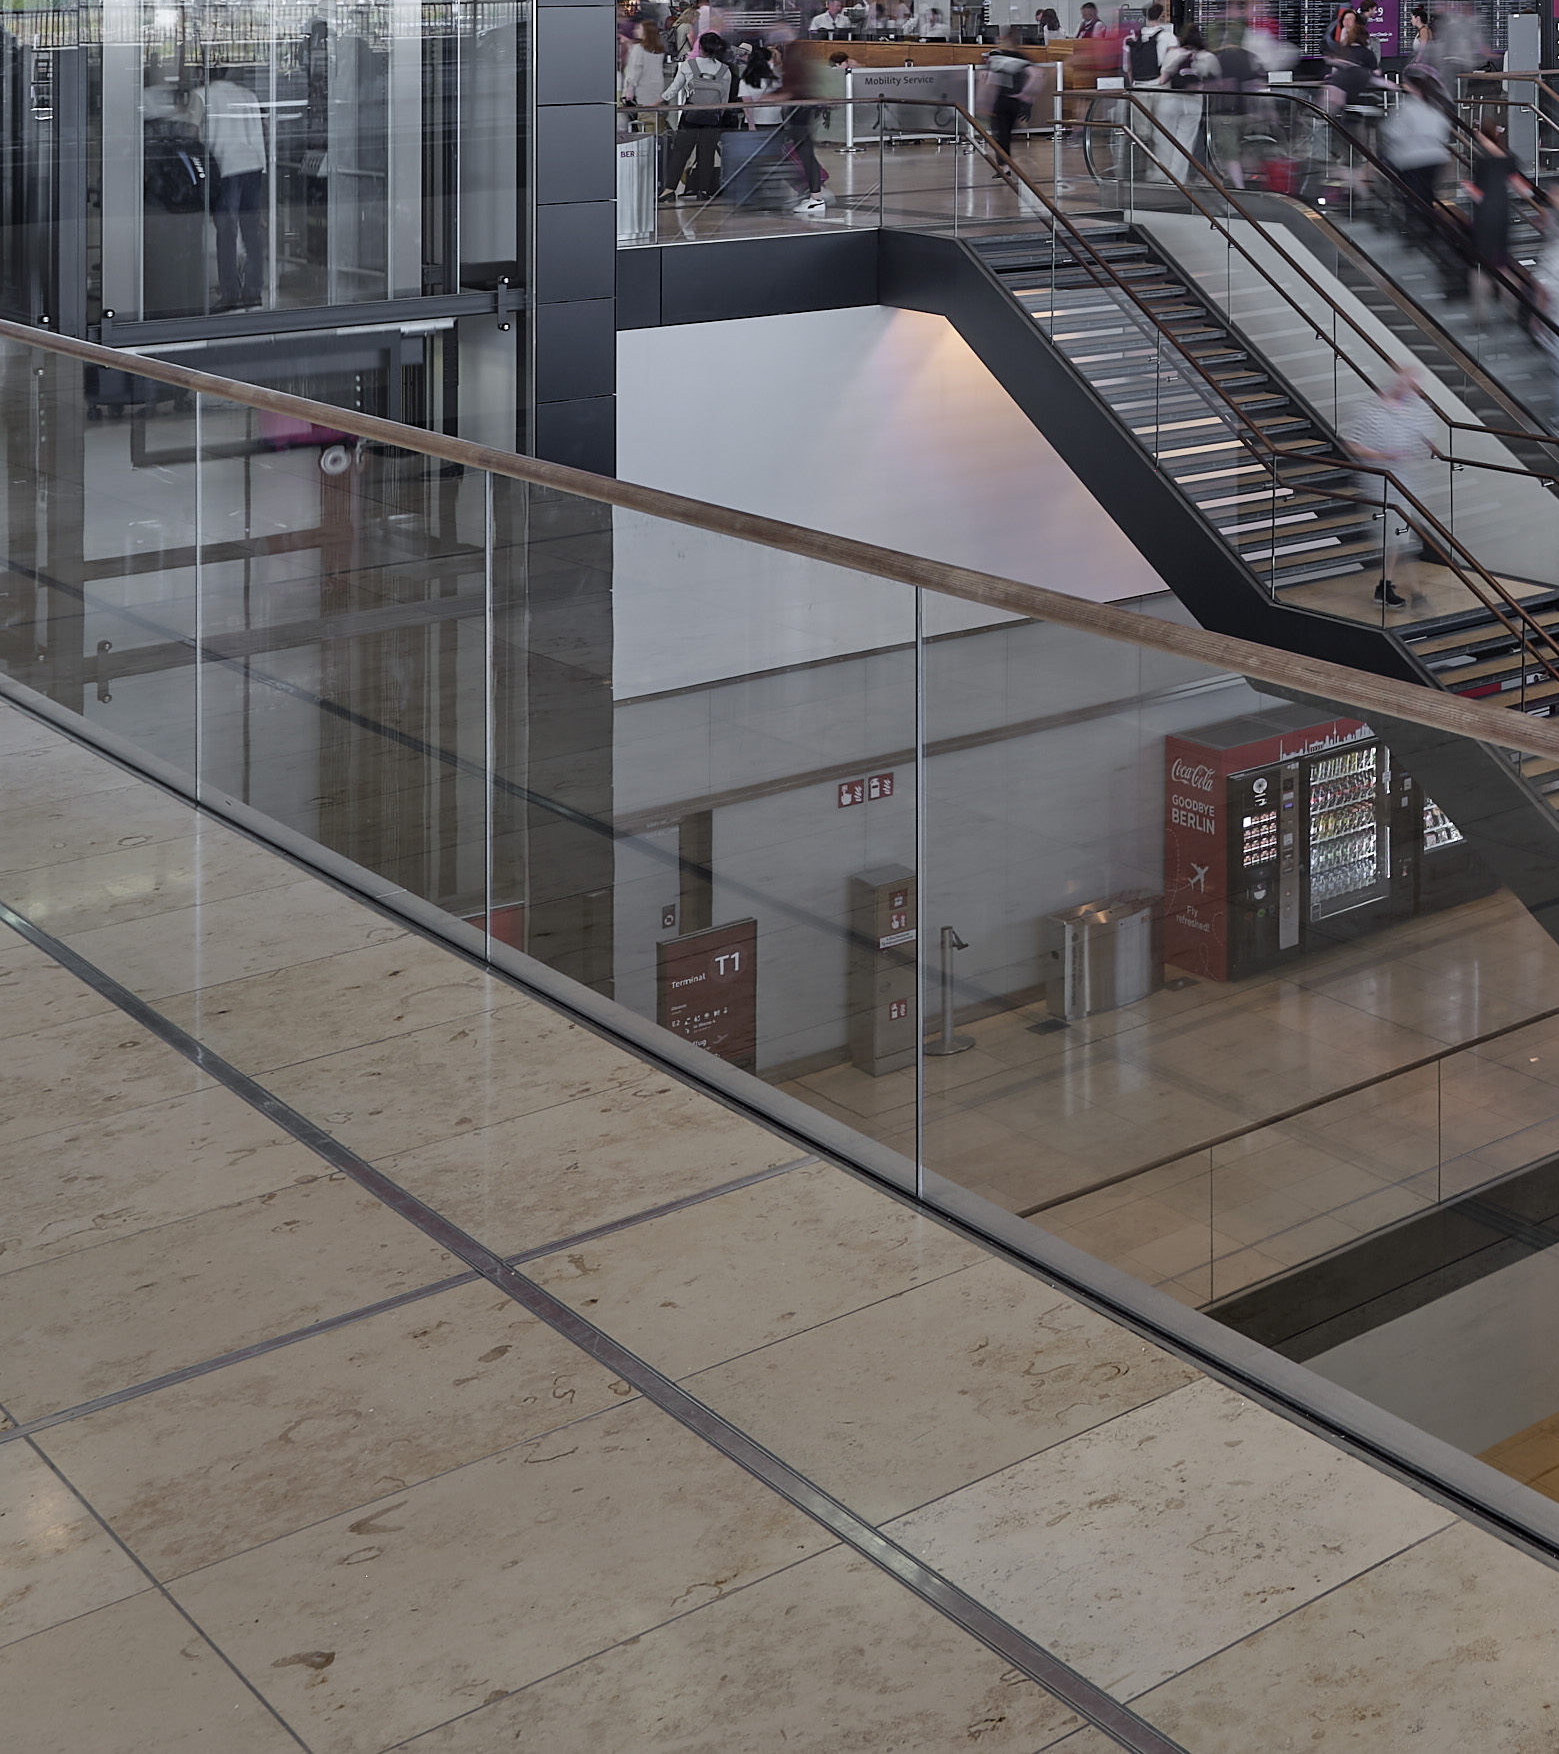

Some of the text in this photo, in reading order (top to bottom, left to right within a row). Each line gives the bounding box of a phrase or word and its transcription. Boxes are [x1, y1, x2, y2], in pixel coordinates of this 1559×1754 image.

[865, 74, 934, 86] Mobility Service
[620, 150, 635, 158] BER
[1171, 757, 1216, 792] Coca-Cola
[1172, 794, 1215, 817] GOODBYE
[1172, 808, 1215, 835] BERLIN
[1186, 904, 1198, 917] Fly
[1176, 912, 1210, 933] refreshed!
[714, 951, 740, 976] T1
[671, 972, 706, 989] Terminal
